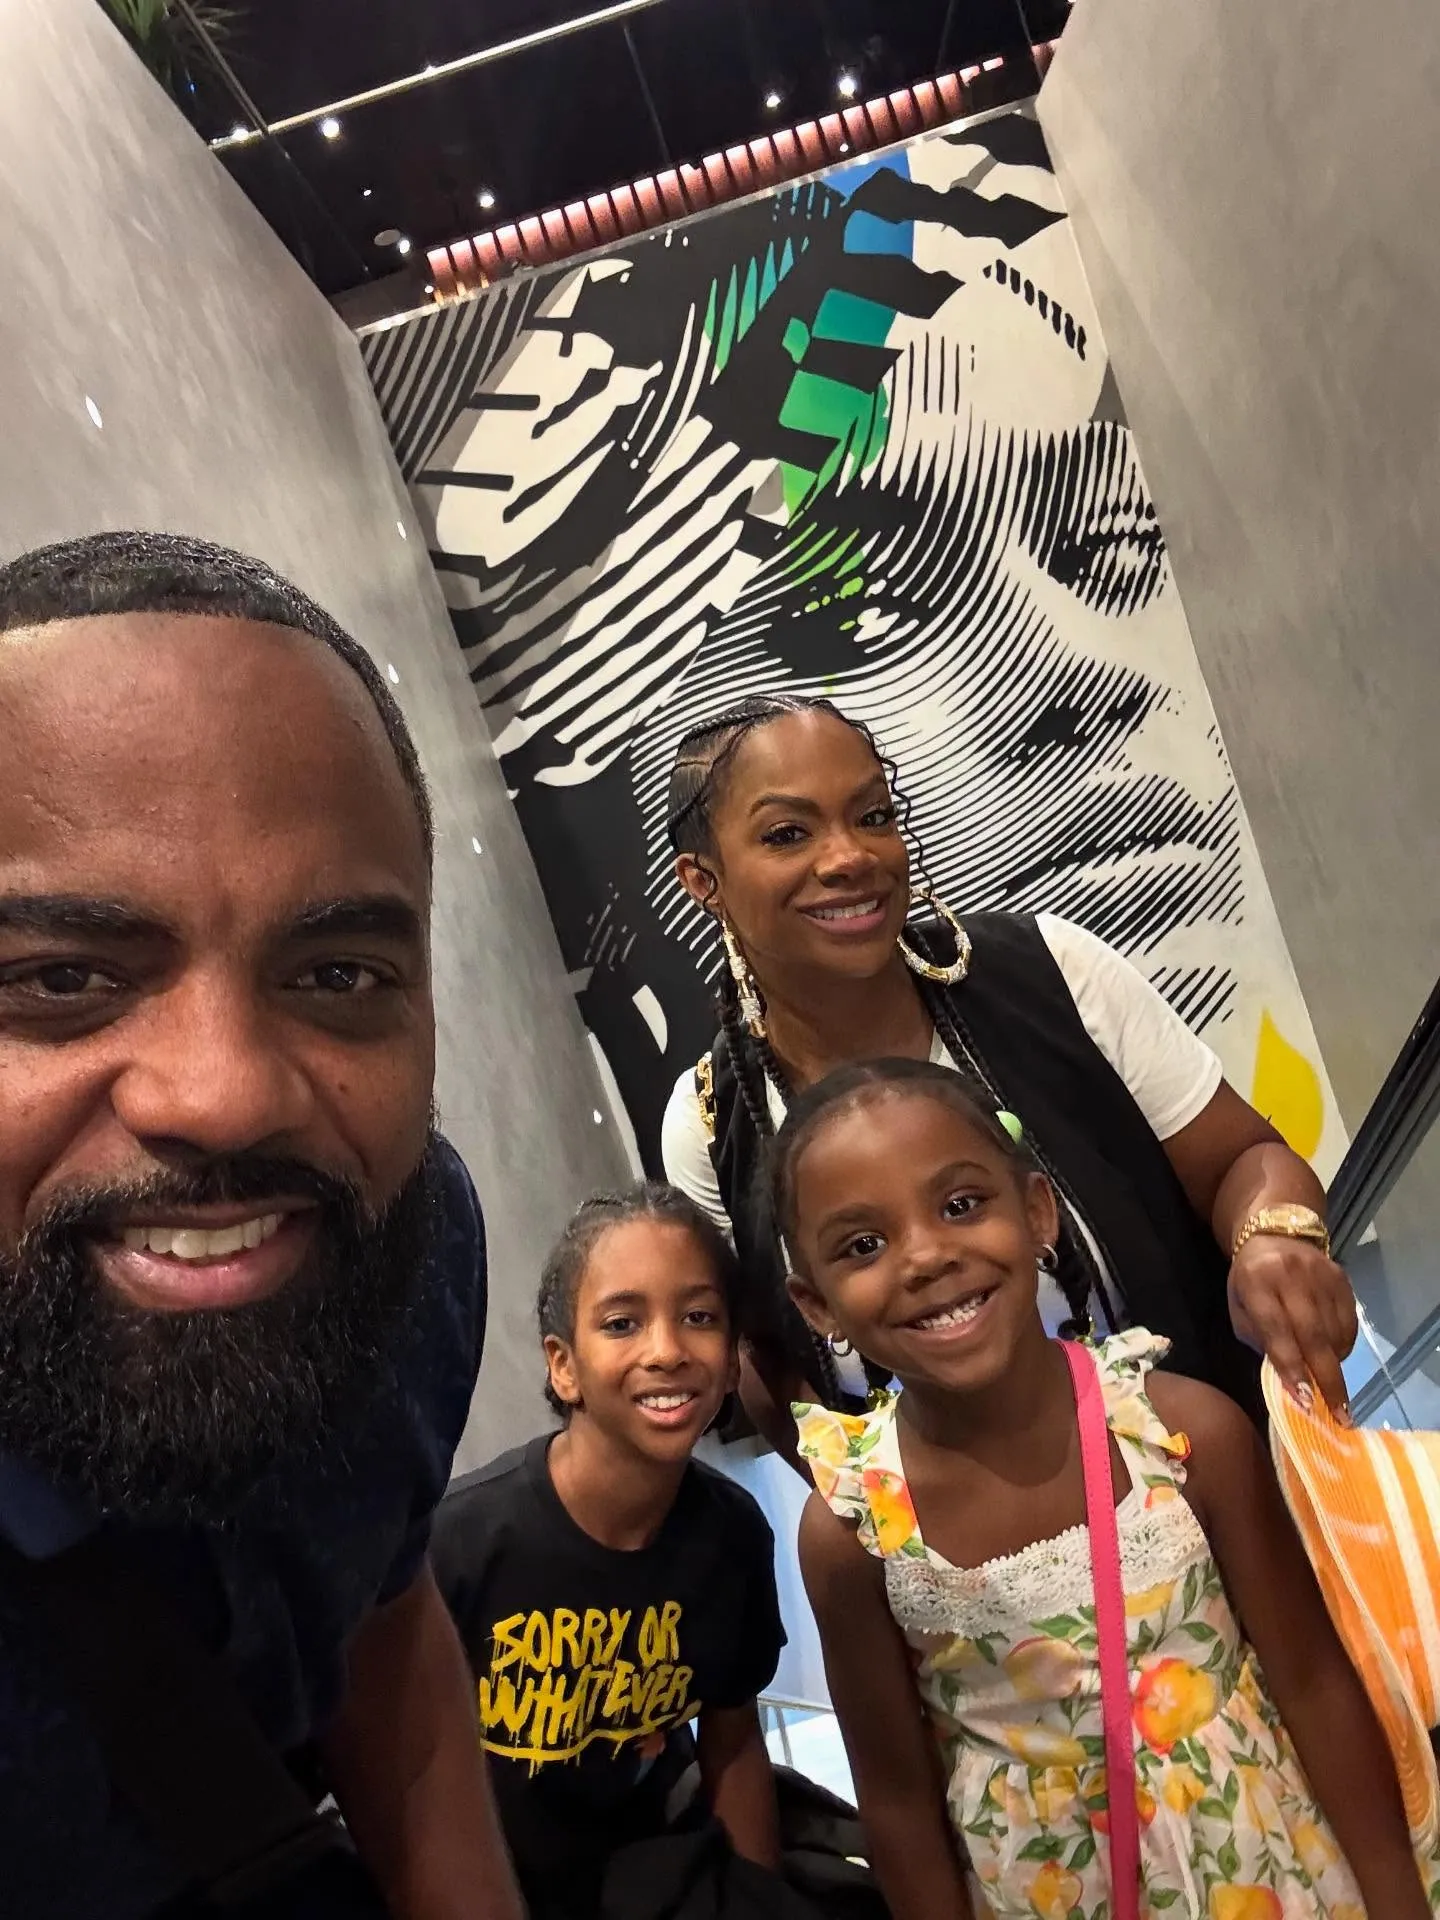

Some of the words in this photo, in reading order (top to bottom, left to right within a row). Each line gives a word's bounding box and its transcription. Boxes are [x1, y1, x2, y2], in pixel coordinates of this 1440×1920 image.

[492, 1607, 632, 1672] SORRY
[638, 1600, 682, 1668] OR
[479, 1659, 694, 1746] WHATEVER
